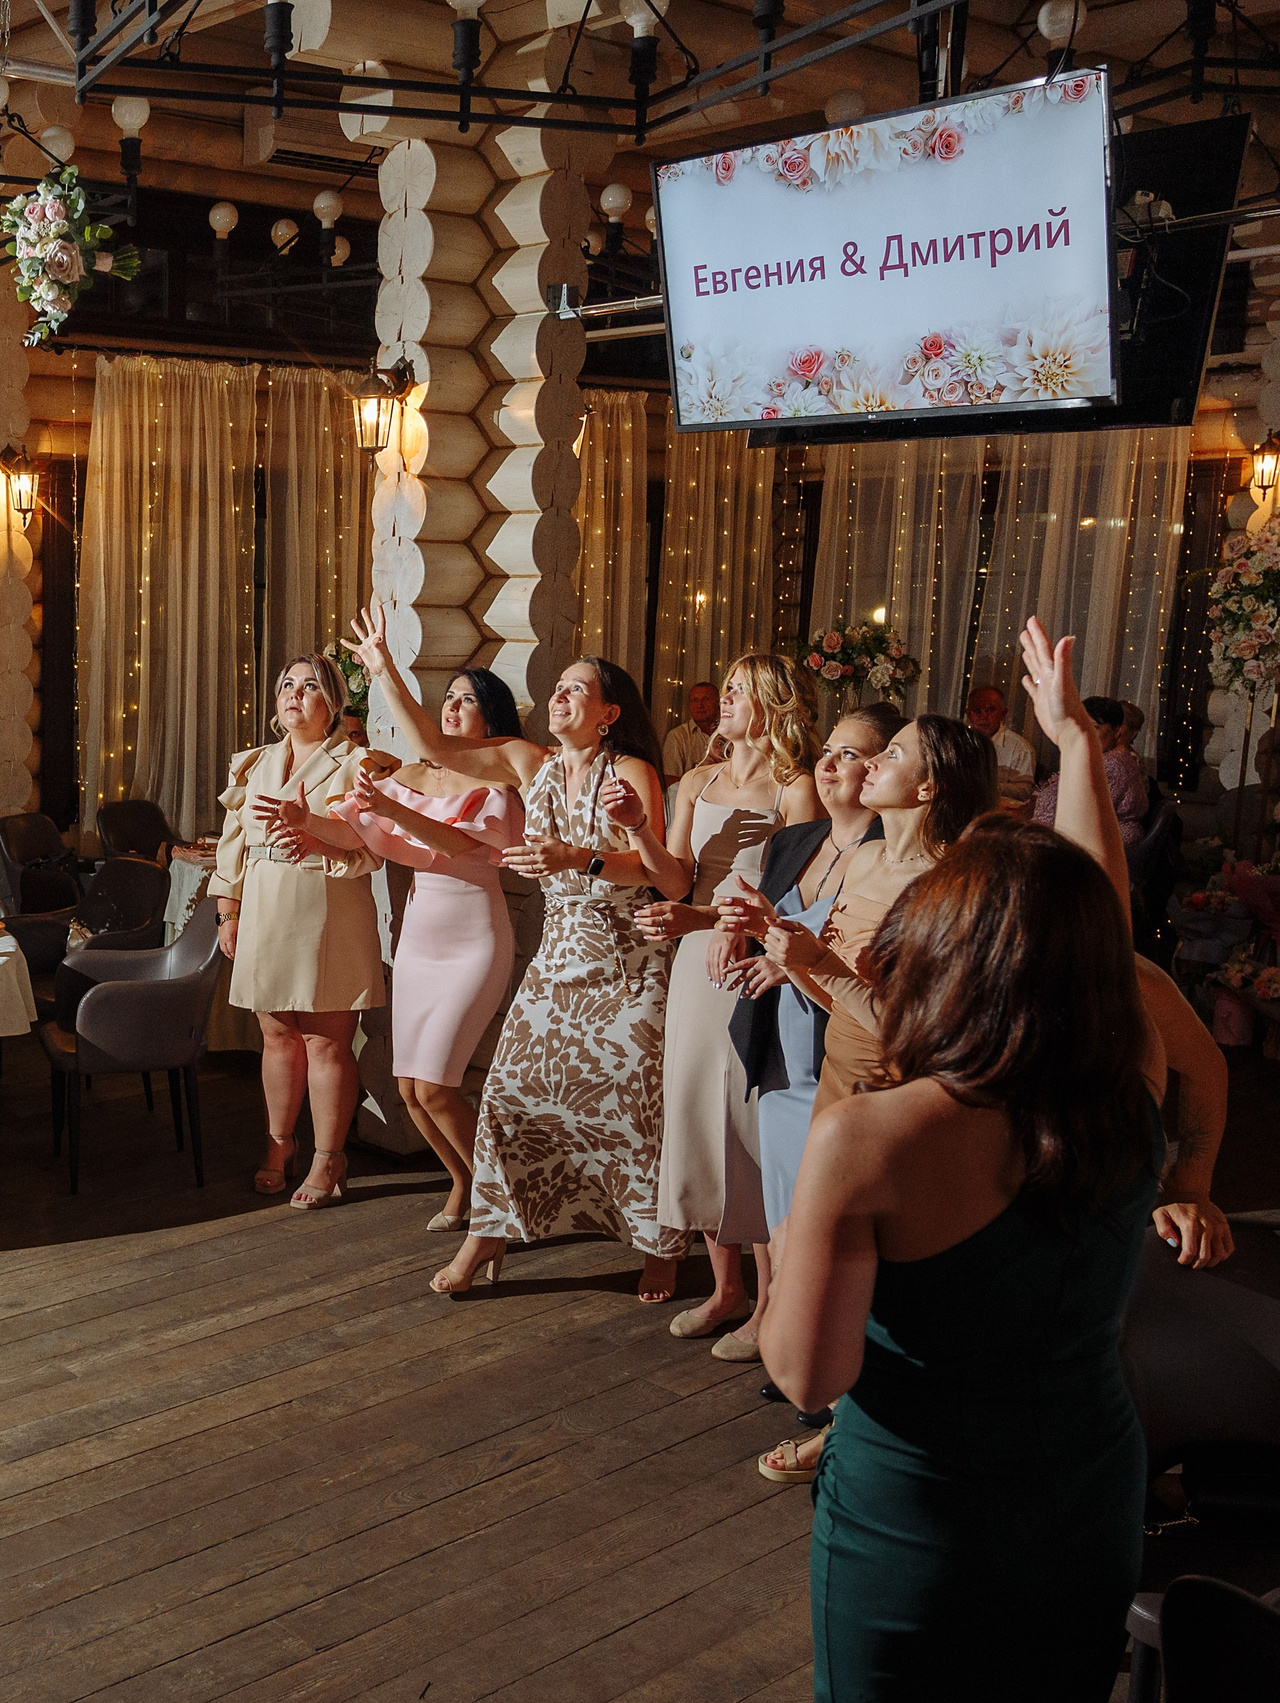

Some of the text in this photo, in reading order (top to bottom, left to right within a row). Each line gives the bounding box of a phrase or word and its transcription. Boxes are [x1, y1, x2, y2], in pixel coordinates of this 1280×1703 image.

[693, 206, 1071, 297] Евгения & Дмитрий
